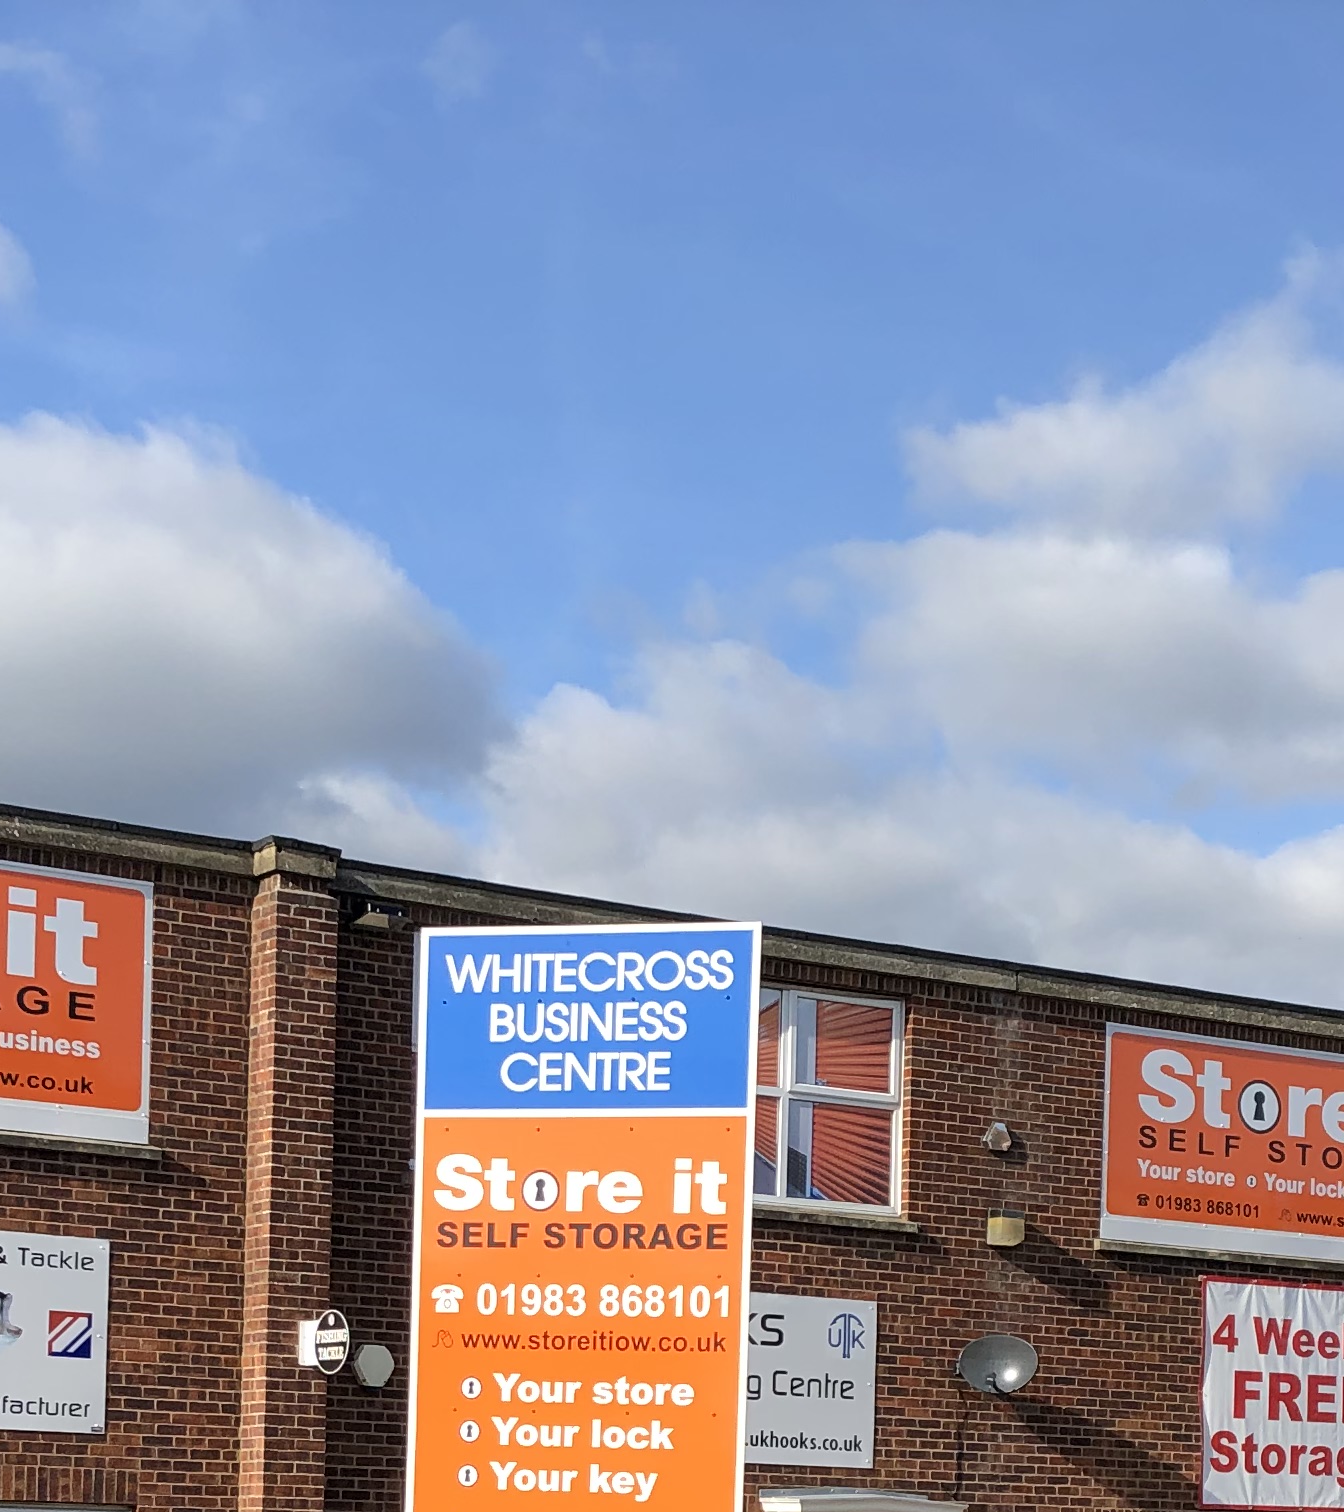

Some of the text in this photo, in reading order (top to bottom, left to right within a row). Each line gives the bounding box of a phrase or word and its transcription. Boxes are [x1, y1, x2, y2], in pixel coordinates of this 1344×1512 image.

[5, 886, 98, 987] it
[445, 949, 734, 994] WHITECROSS
[490, 1000, 687, 1043] BUSINESS
[500, 1051, 671, 1092] CENTRE
[1138, 1125, 1241, 1158] SELF
[434, 1153, 728, 1216] Store it
[1138, 1159, 1181, 1182] Your
[1186, 1166, 1235, 1188] store
[1264, 1172, 1305, 1196] Your
[1155, 1195, 1201, 1213] 01983
[1206, 1200, 1260, 1219] 868101
[437, 1222, 728, 1250] SELF STORAGE
[18, 1247, 95, 1272] Tackle
[477, 1283, 730, 1318] 01983 868101
[462, 1330, 727, 1354] www.storeitiow.co.uk
[1213, 1314, 1238, 1353] 4
[493, 1373, 695, 1406] Your store
[773, 1370, 854, 1400] Centre
[491, 1416, 674, 1450] Your lock
[490, 1460, 657, 1502] Your key
